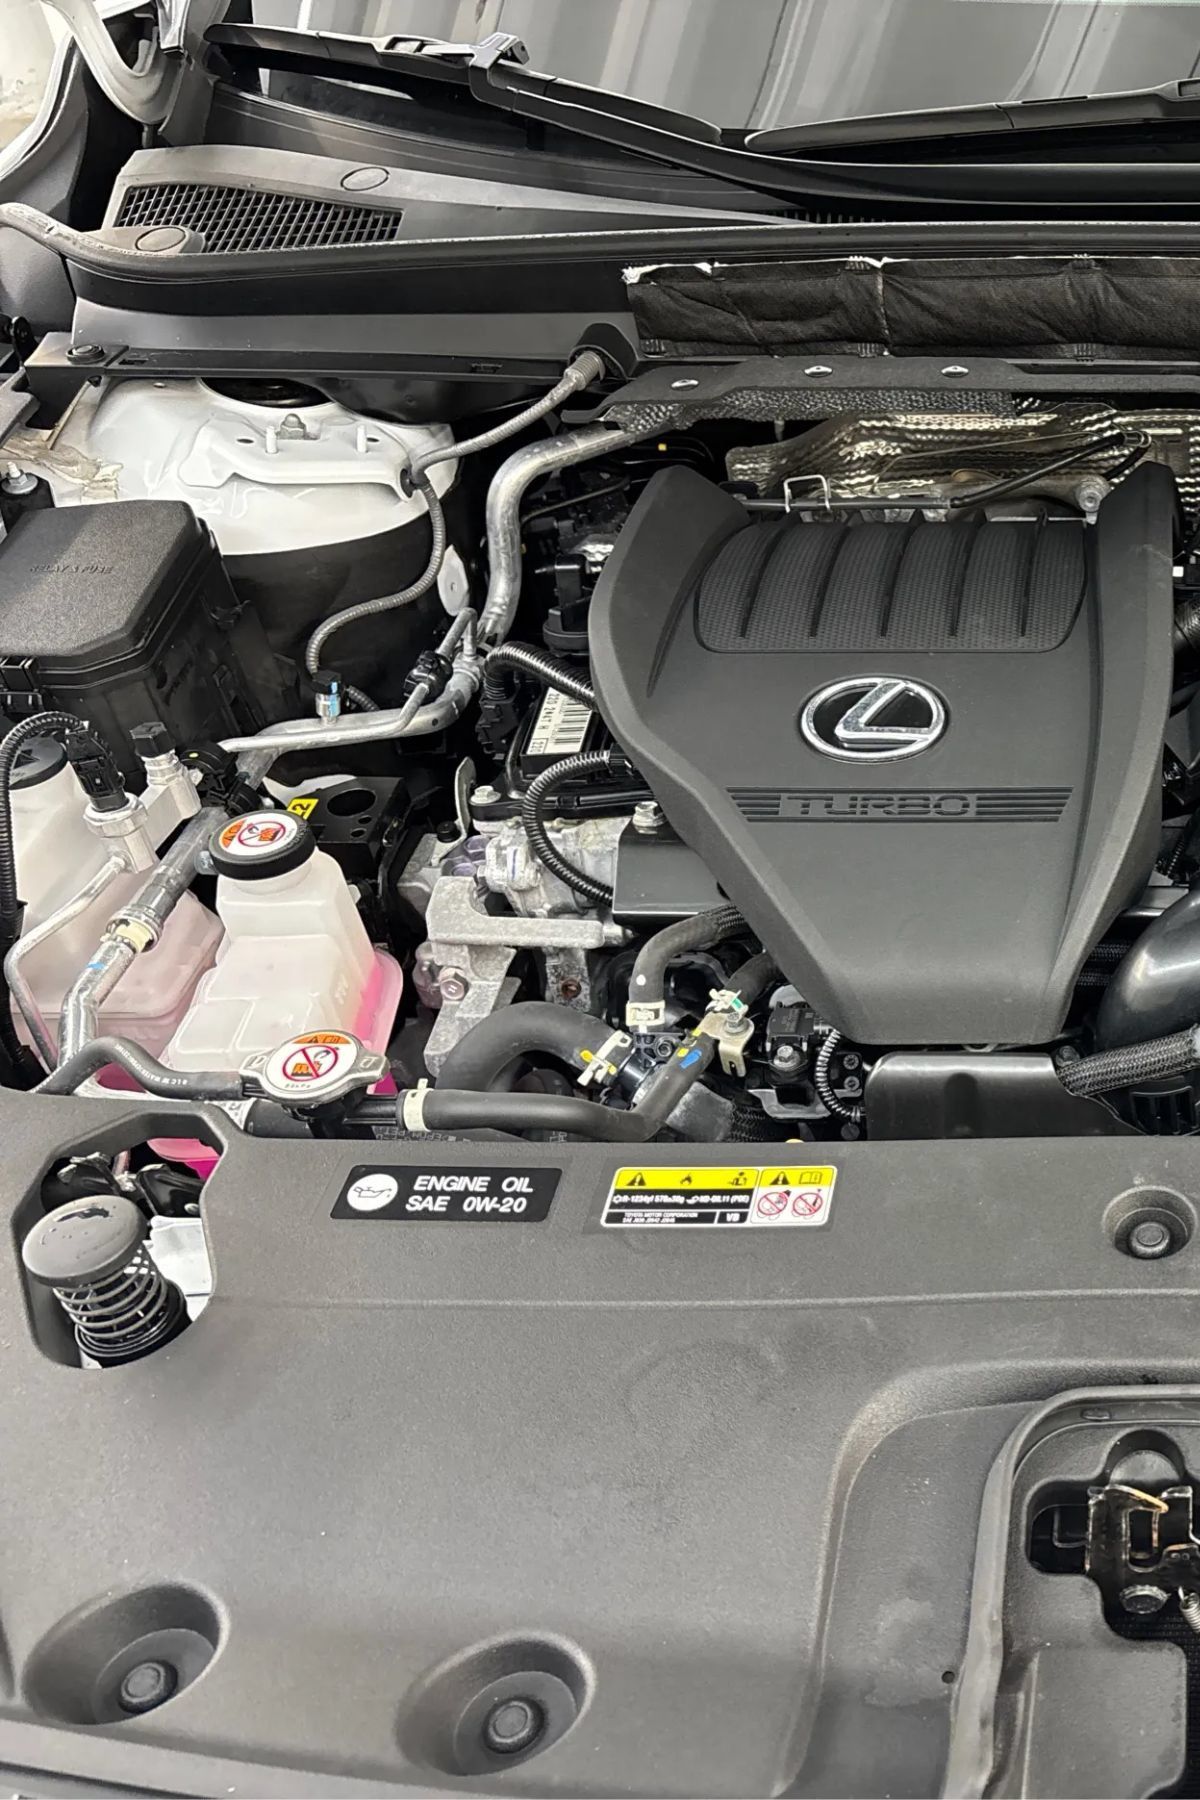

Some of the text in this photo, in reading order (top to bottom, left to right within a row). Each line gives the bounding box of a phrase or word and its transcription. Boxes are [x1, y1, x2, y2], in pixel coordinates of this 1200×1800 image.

[786, 795, 971, 816] TURBO
[413, 1175, 534, 1193] ENGINE OIL
[405, 1195, 527, 1213] SAE 0W-20
